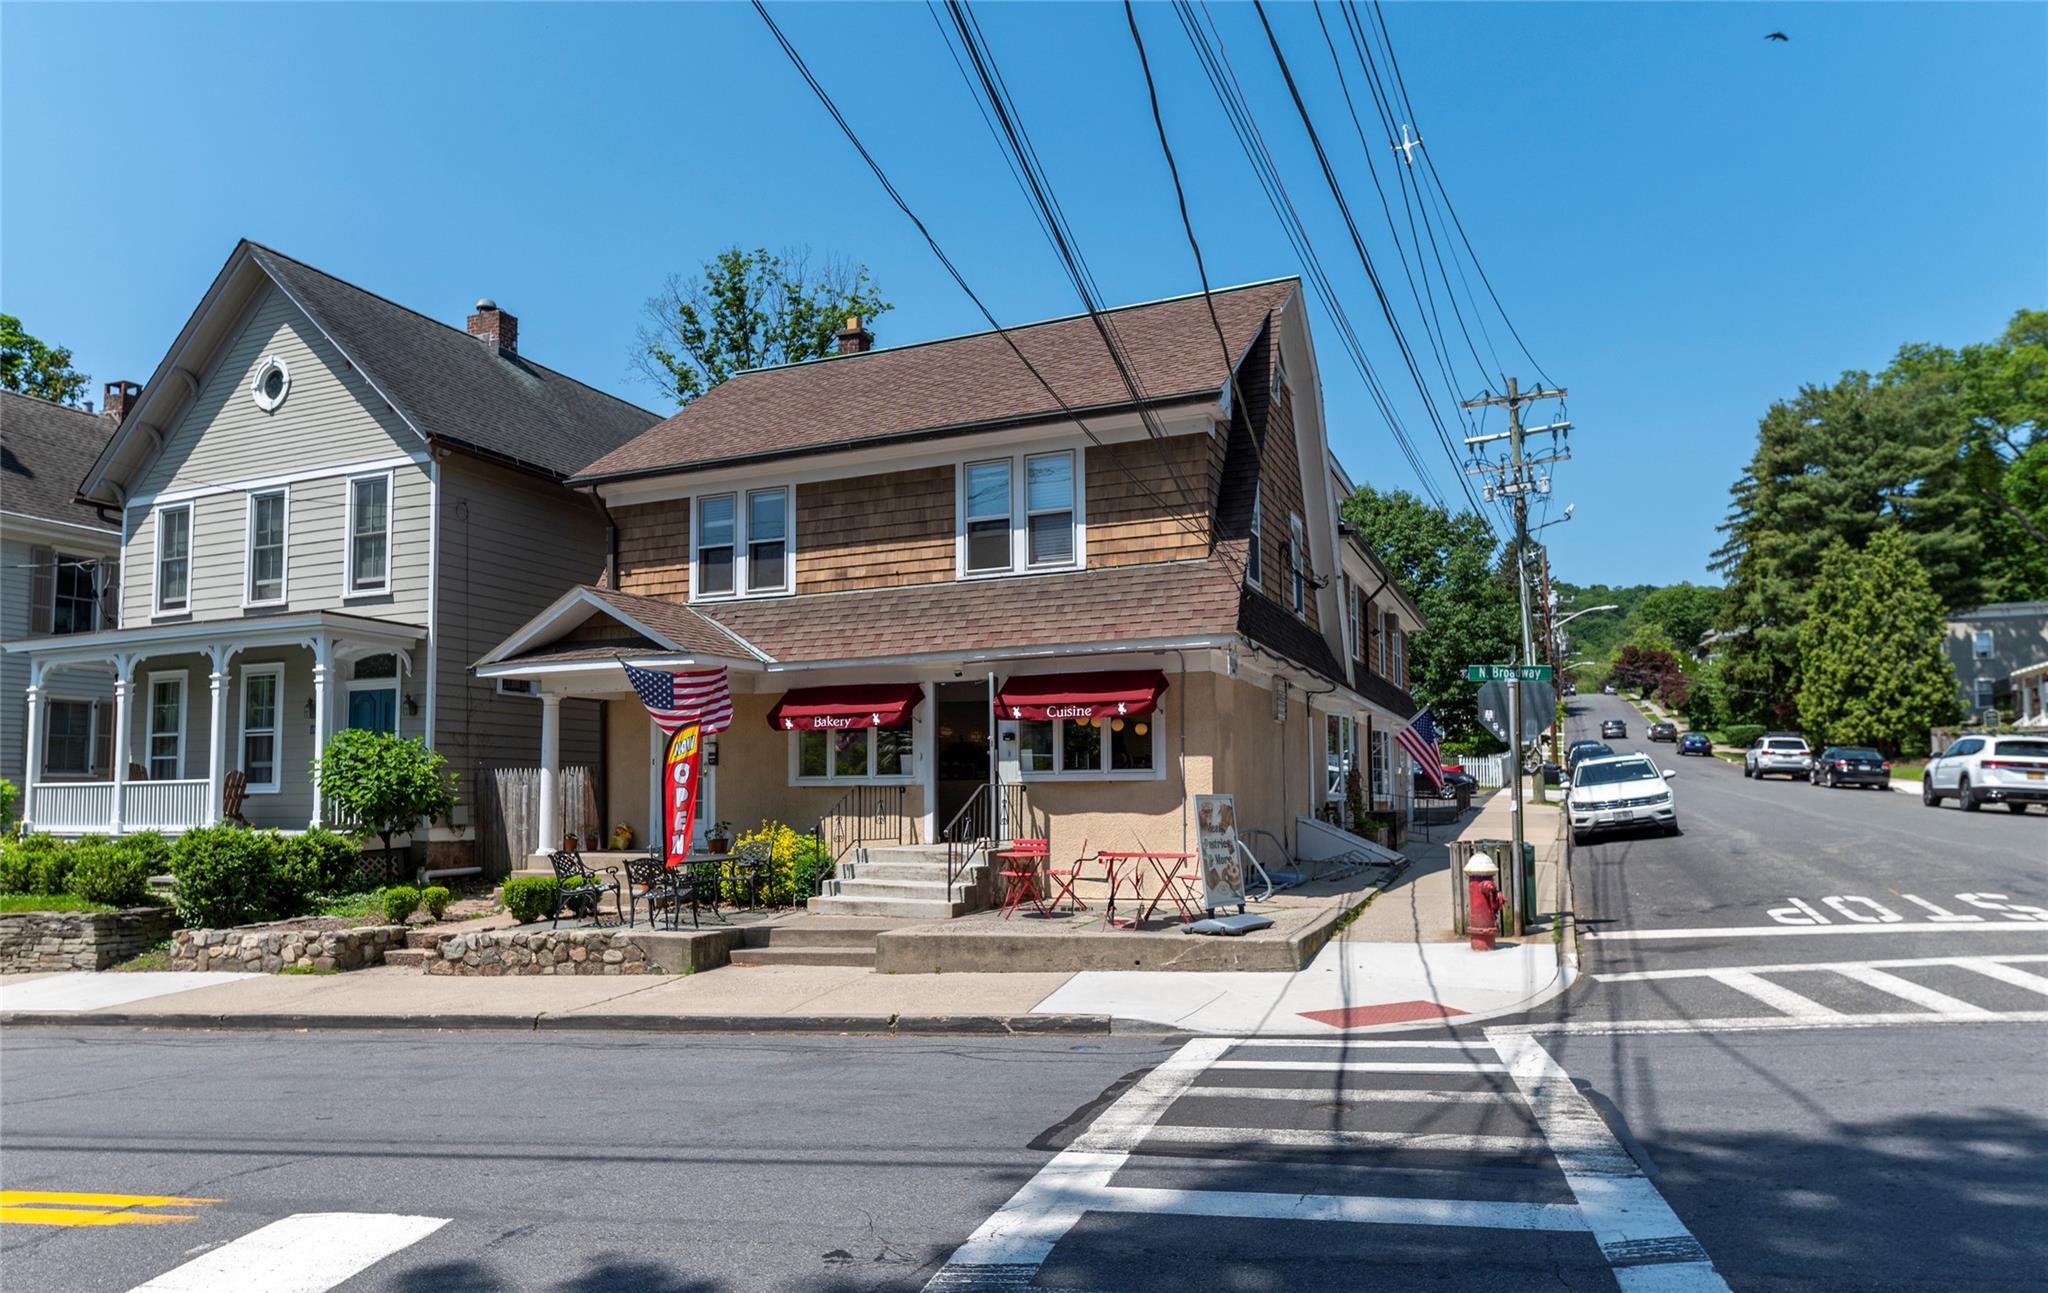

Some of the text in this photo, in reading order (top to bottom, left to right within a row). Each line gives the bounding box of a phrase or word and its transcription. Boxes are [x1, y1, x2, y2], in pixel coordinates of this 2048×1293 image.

[1479, 667, 1541, 680] N. Broadway
[1046, 705, 1092, 718] Cuisine
[814, 715, 852, 728] Bakery
[673, 735, 695, 758] NOW
[671, 762, 691, 855] OPEN
[1767, 893, 2048, 925] STOP
